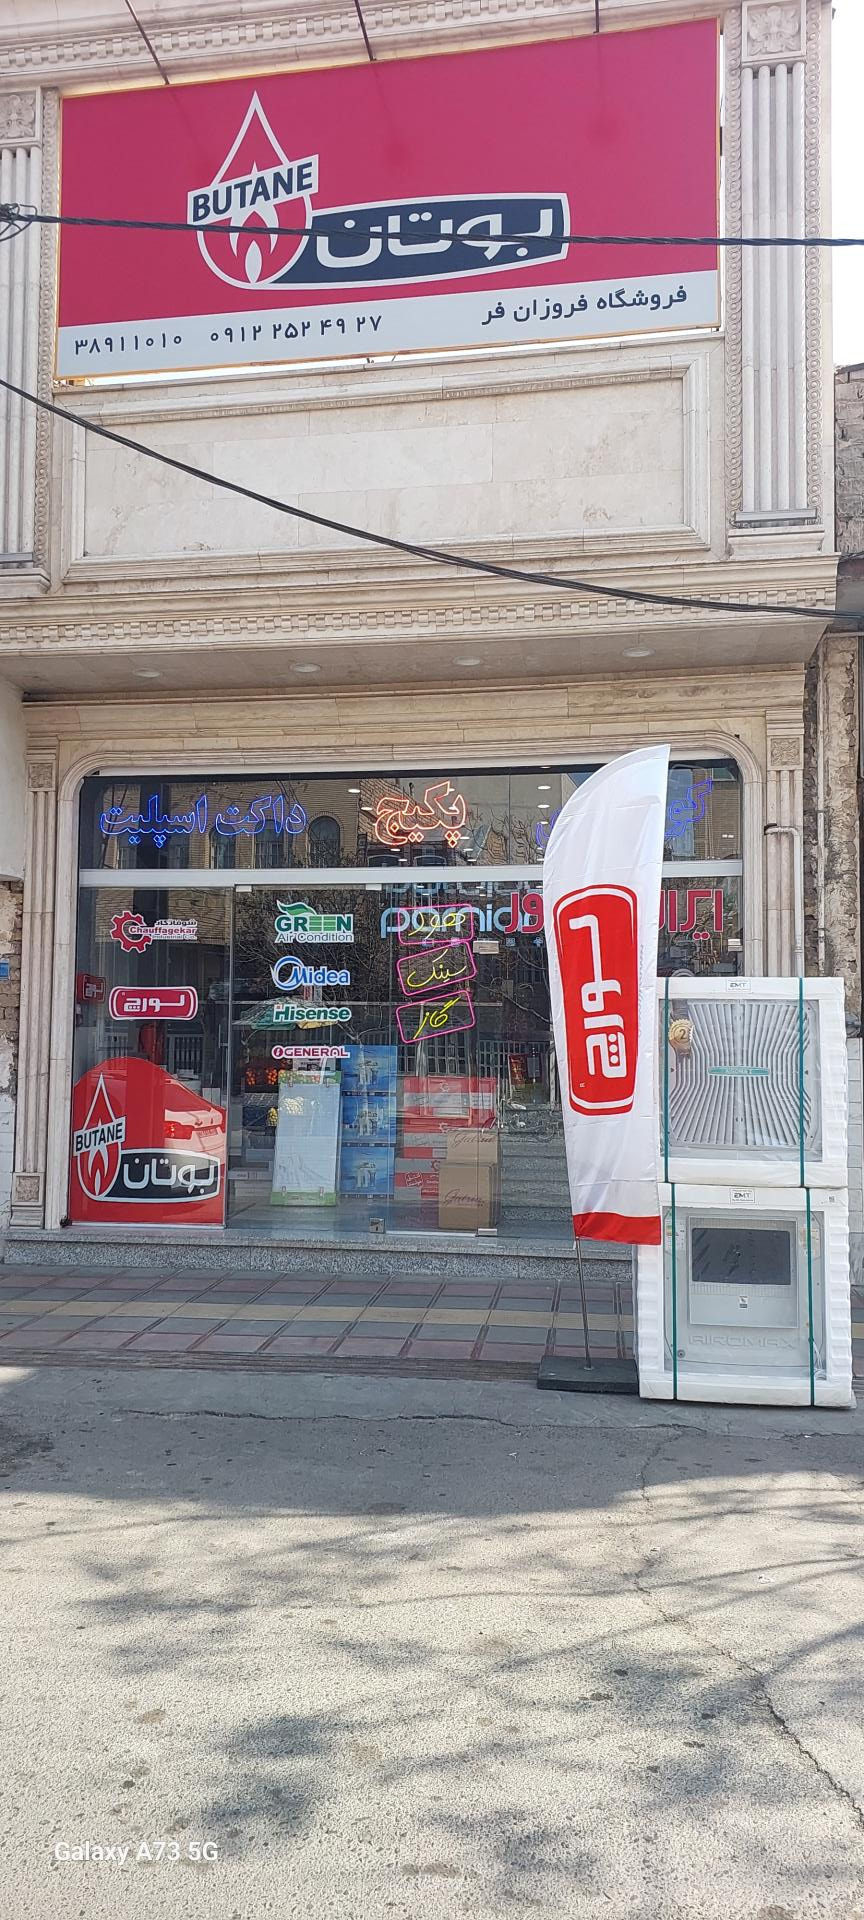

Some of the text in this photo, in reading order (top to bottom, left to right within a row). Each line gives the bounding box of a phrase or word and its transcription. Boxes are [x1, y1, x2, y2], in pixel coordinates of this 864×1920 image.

[192, 160, 314, 223] BUTANE
[316, 207, 553, 269] بوتان
[482, 285, 688, 326] فروشگاه فروزان فر
[99, 793, 308, 849] داکت اسپلیت
[374, 780, 467, 849] پکیج
[129, 926, 198, 935] Chauffagekar
[276, 915, 352, 932] GREEN
[659, 889, 724, 940] ایرا
[277, 932, 354, 942] Air Condition
[280, 962, 350, 986] Midea
[406, 948, 467, 988] سینک
[123, 994, 186, 1013] لورچ
[274, 1004, 351, 1021] Hisense
[568, 913, 628, 1079] لورچ
[412, 995, 462, 1040] گاز
[285, 1047, 350, 1058] GENERAL
[75, 1122, 123, 1152] BUTANE
[123, 1157, 215, 1195] بوتان
